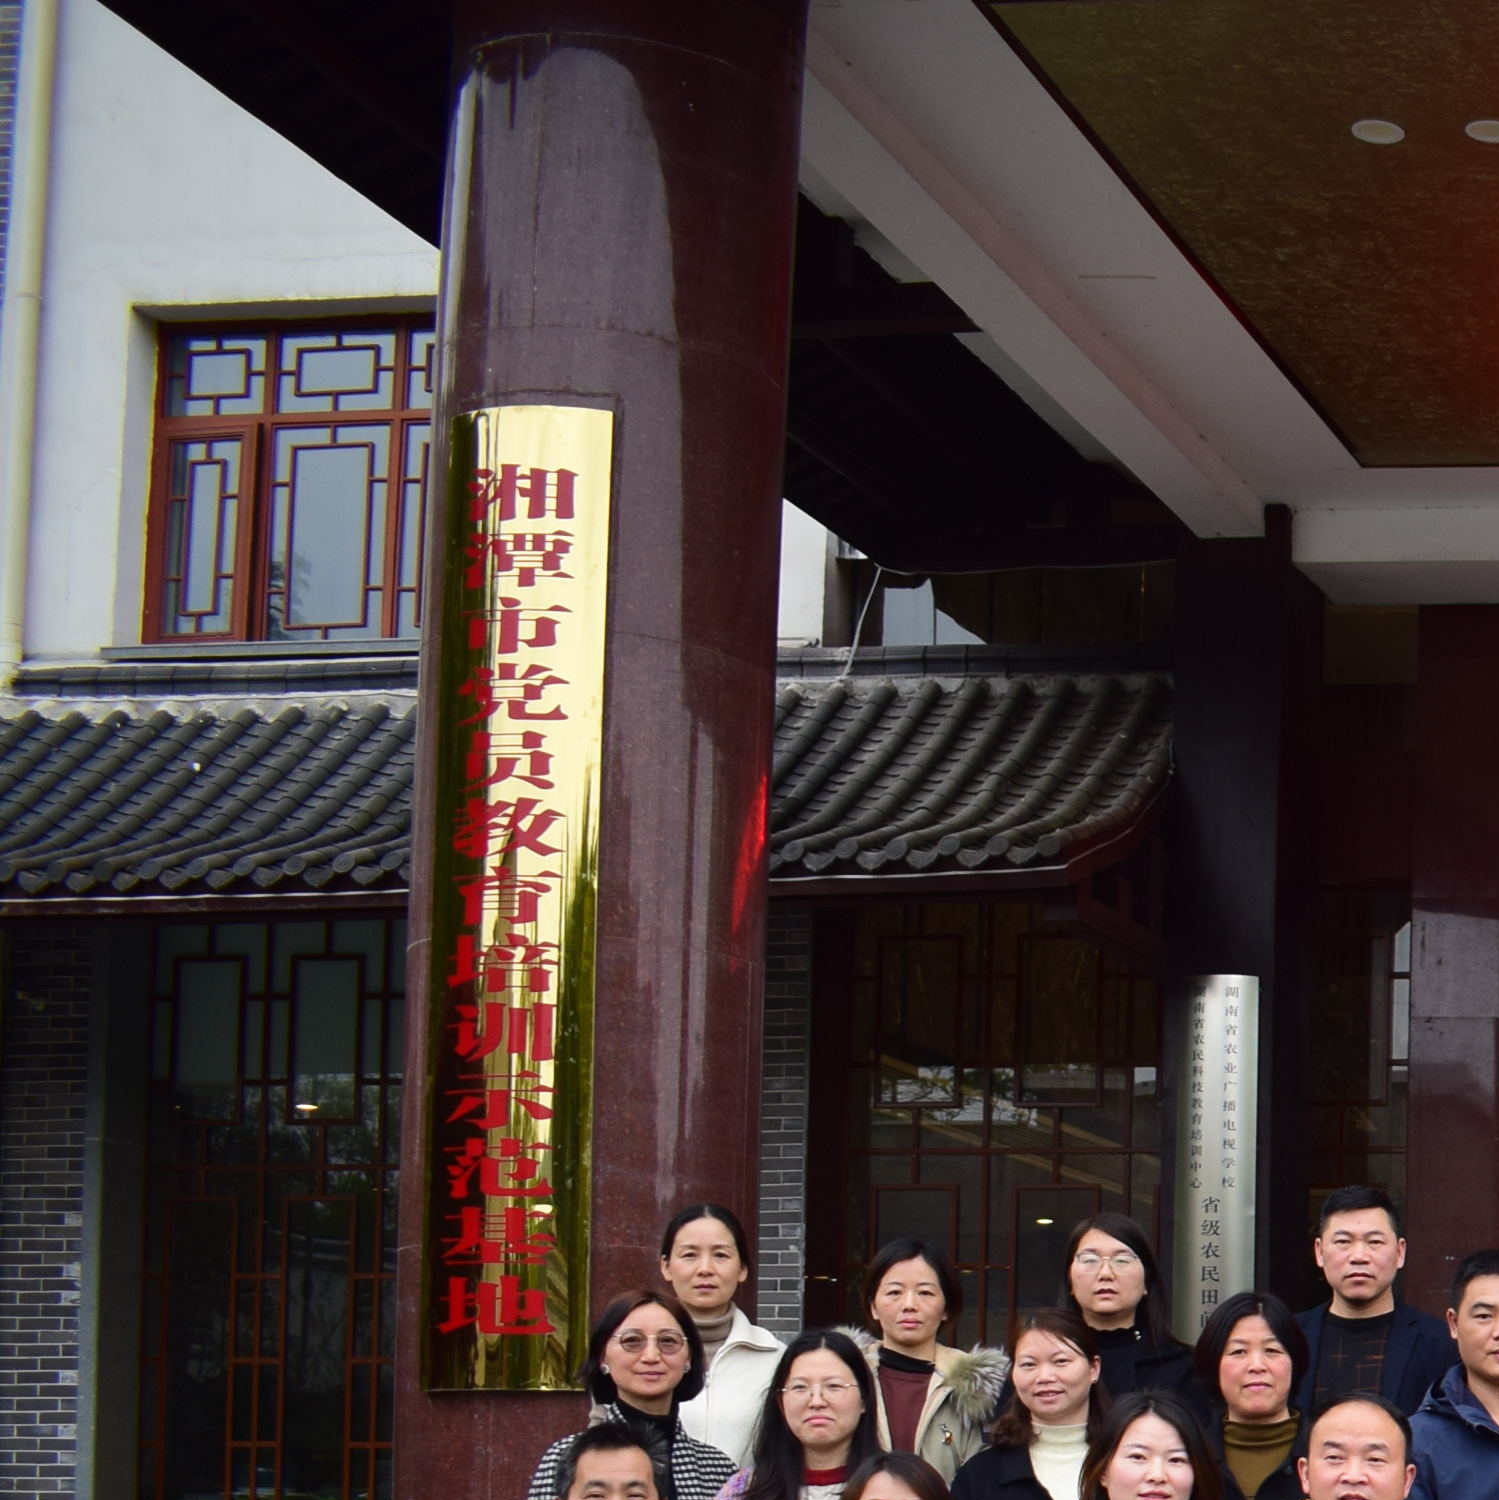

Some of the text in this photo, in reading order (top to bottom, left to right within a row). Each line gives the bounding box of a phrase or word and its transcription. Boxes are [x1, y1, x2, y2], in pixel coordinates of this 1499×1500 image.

[437, 463, 580, 1338] 湘潭市党员教育培训示范基地
[1221, 985, 1240, 1189] 湖南省农业广播电视学校
